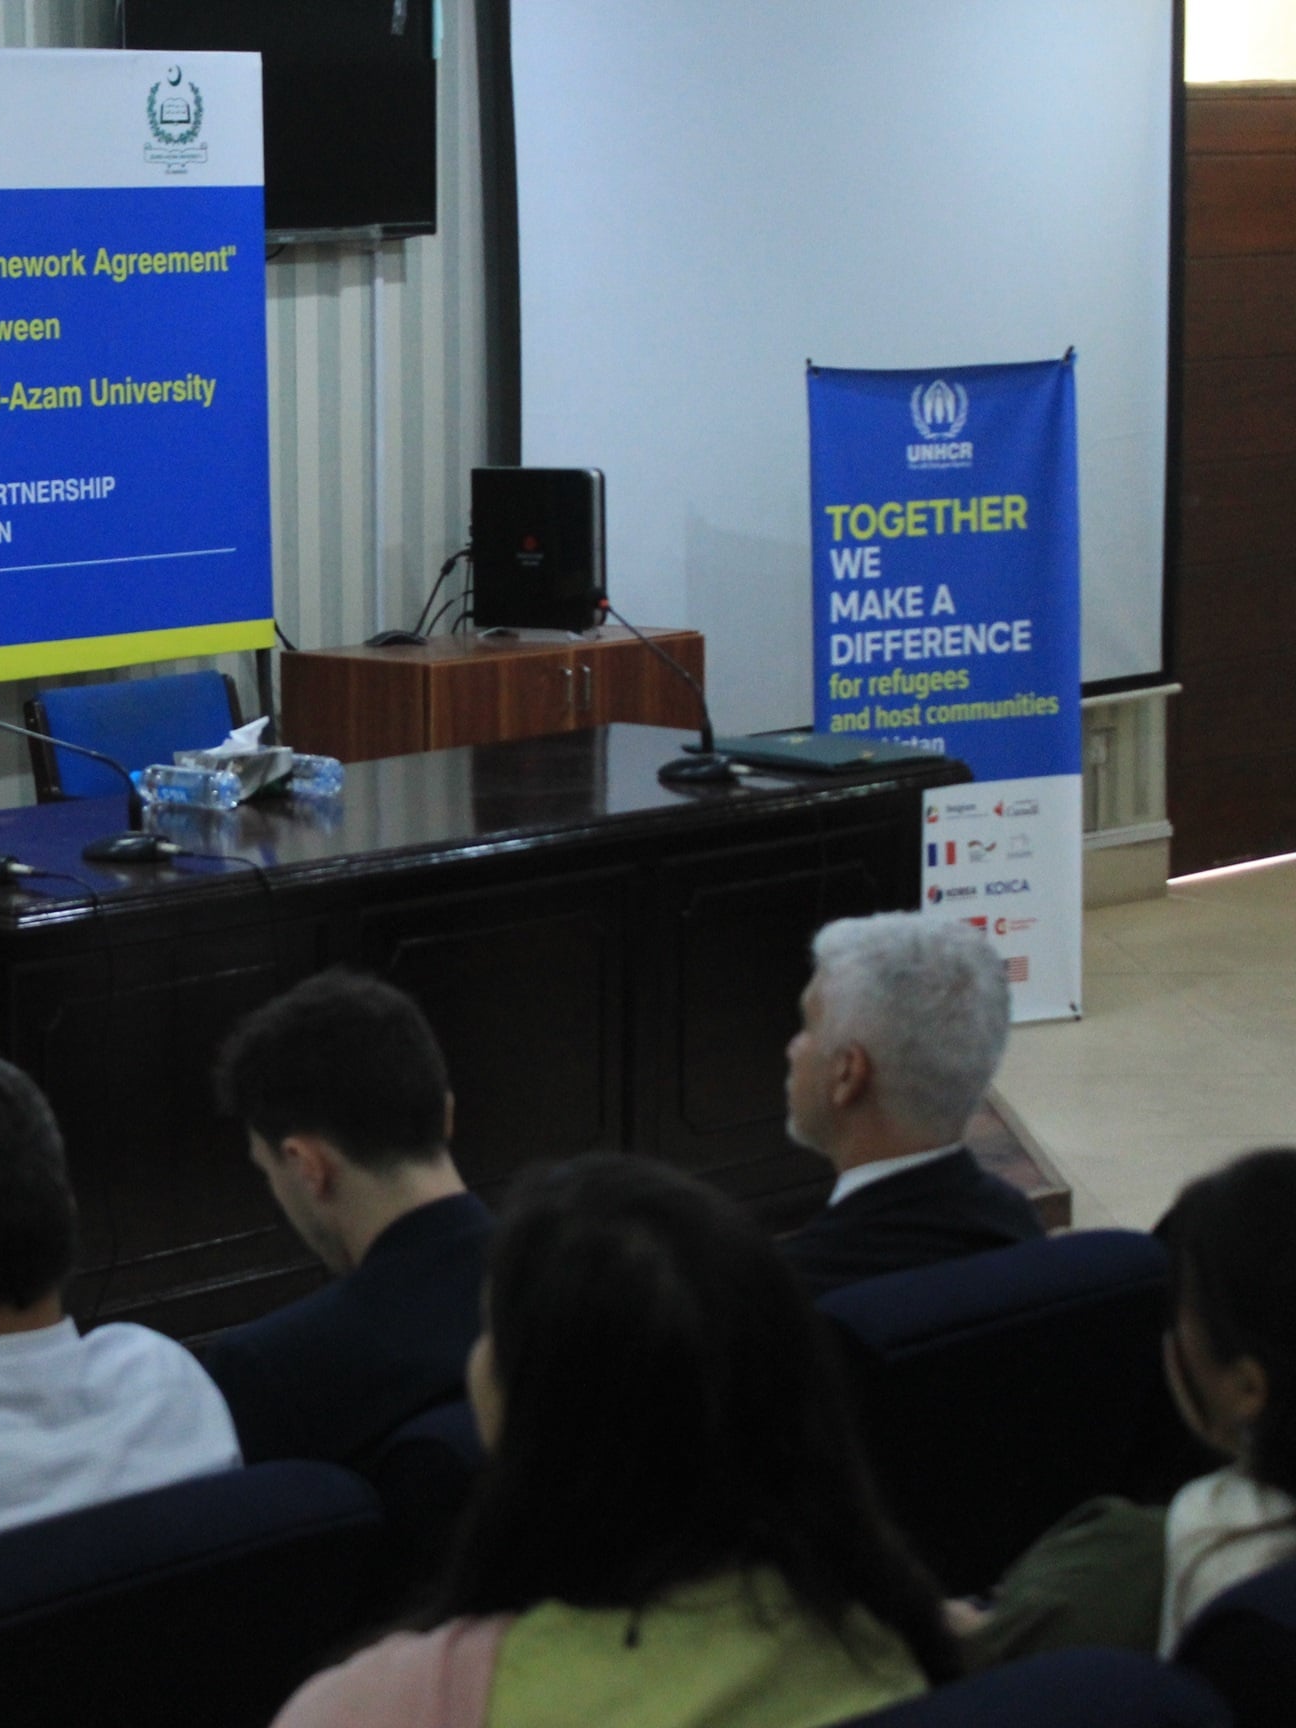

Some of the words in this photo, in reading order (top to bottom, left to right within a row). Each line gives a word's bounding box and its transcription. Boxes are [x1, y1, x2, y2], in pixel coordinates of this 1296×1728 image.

[90, 373, 217, 408] University
[906, 441, 974, 462] UNHCR
[824, 494, 1029, 541] TOGETHER
[830, 546, 882, 580] WE
[830, 585, 924, 623] MAKE
[930, 583, 956, 616] A
[830, 619, 1032, 667] DIFFERENCE
[829, 672, 863, 700] for
[868, 667, 970, 700] refugees
[830, 705, 871, 733] and
[874, 702, 922, 729] host
[925, 690, 1060, 725] communities
[984, 878, 1031, 896] KOICA
